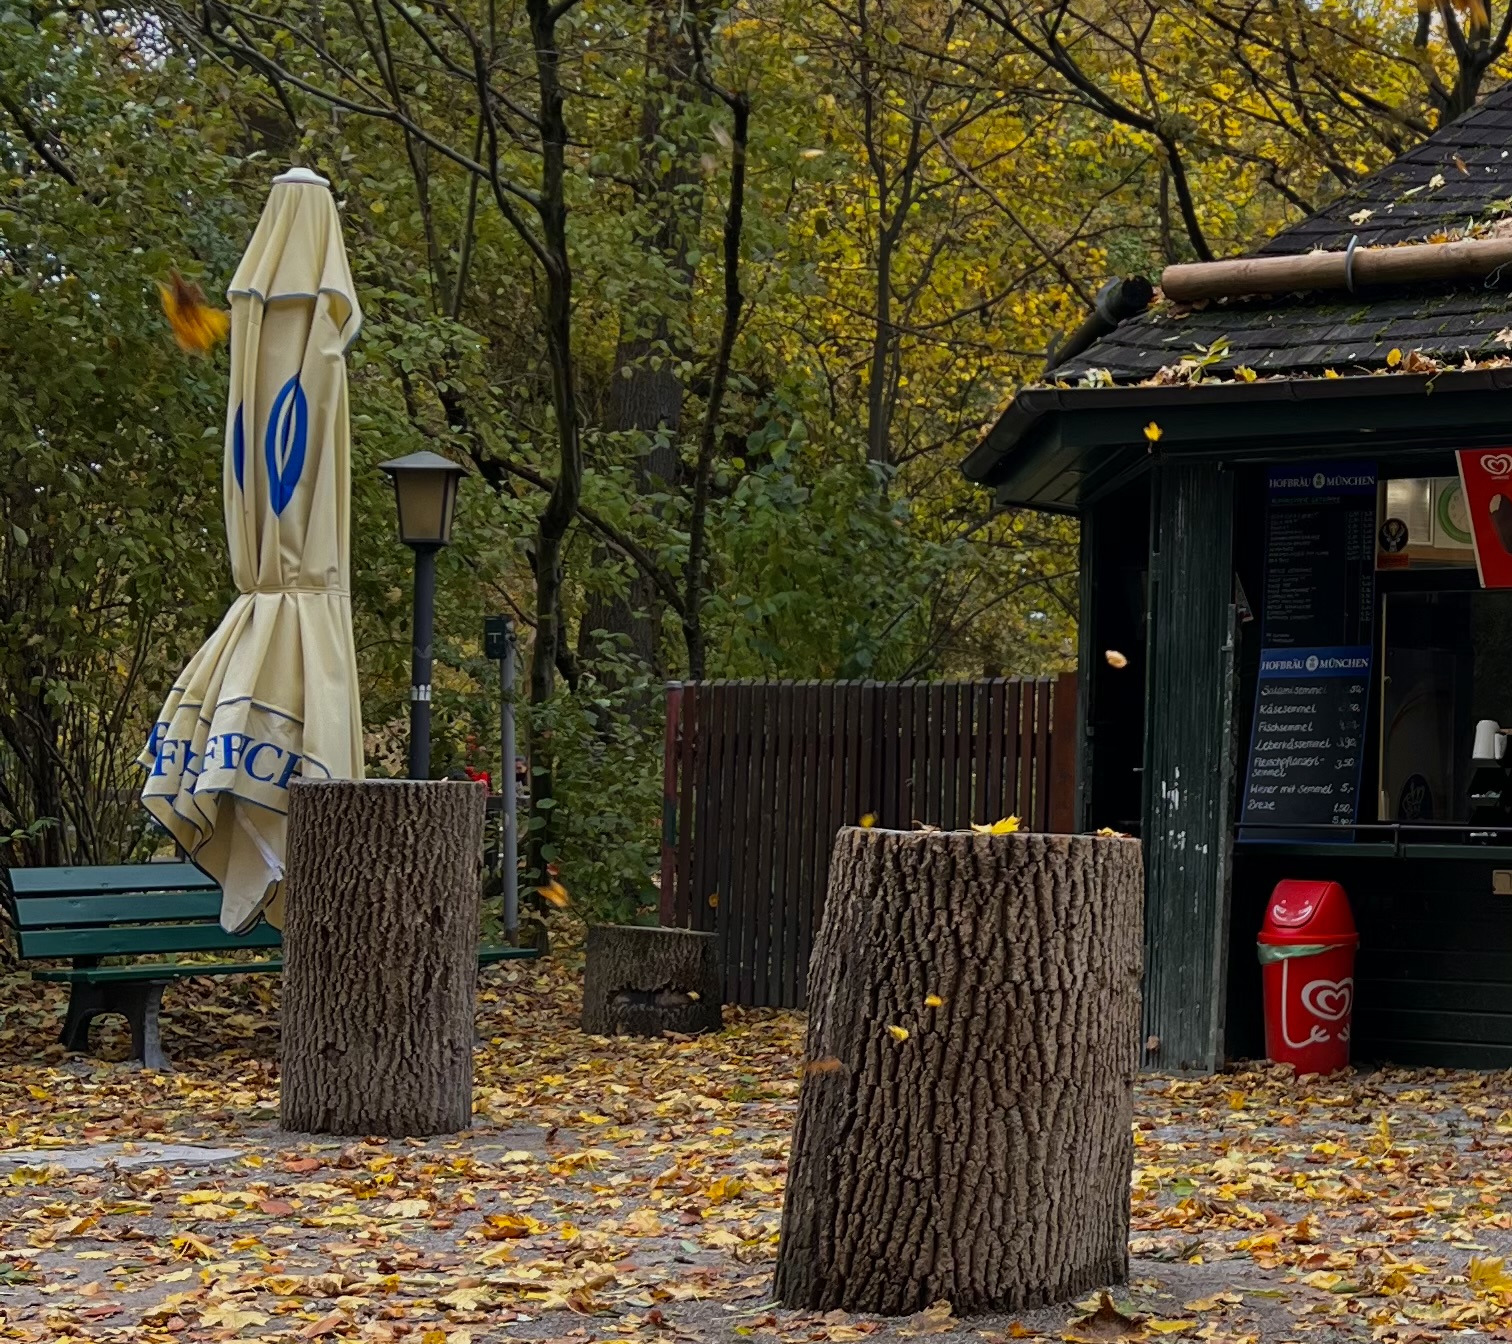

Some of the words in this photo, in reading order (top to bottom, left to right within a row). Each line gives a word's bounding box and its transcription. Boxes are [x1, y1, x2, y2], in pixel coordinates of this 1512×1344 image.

[1269, 476, 1311, 488] HOFBRÄU
[1326, 475, 1375, 487] MÜNCHEN
[1261, 658, 1304, 670] HOFBRÄU
[1319, 657, 1369, 668] MÜNCHEN
[1259, 703, 1317, 714] Käsesemmel
[1258, 721, 1313, 733] Fischsemmel
[1250, 783, 1278, 794] Wiener
[1280, 783, 1295, 794] mit
[1247, 798, 1276, 811] Breze
